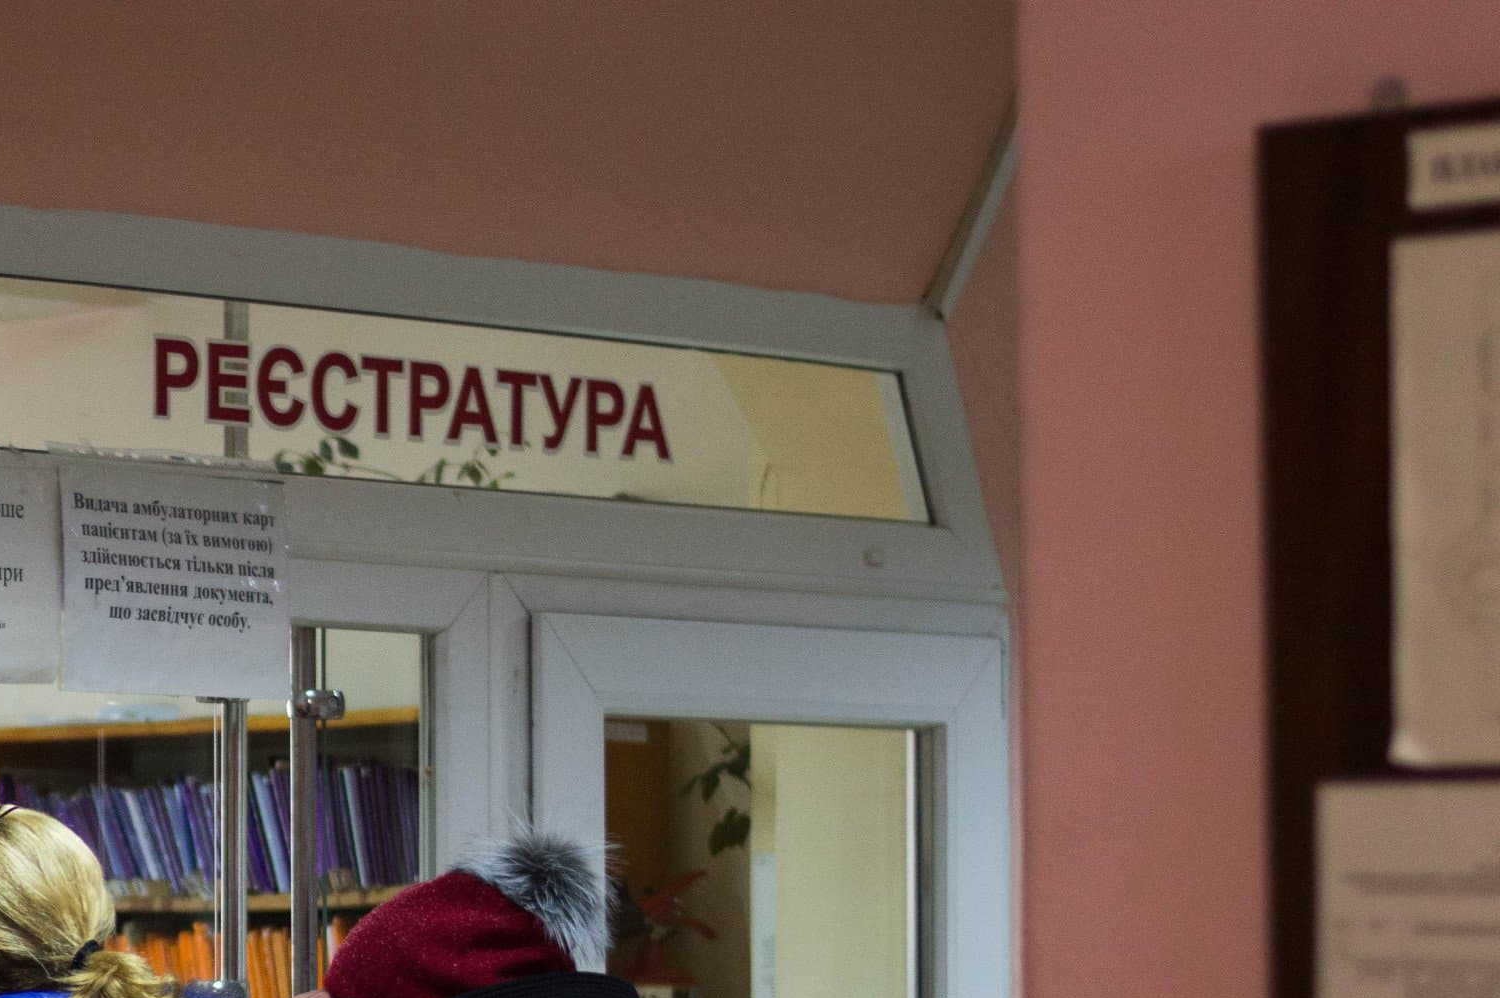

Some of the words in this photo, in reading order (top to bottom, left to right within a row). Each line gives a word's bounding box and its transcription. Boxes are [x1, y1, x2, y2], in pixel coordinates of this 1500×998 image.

[154, 337, 672, 461] РЕЄСТРАТУРА
[73, 492, 128, 514] Видача
[132, 500, 239, 524] амбулаторних
[242, 514, 276, 531] карт
[81, 522, 158, 543] пацієнтам
[161, 527, 182, 548] (за
[186, 529, 199, 547] їх
[203, 536, 274, 555] вимогою)
[80, 547, 181, 571] здійснюється
[186, 555, 234, 576] тільки
[238, 562, 276, 579] після
[193, 588, 275, 606] документа,
[109, 605, 132, 622] що
[135, 606, 204, 630] засвідчує
[208, 611, 251, 634] особу.
